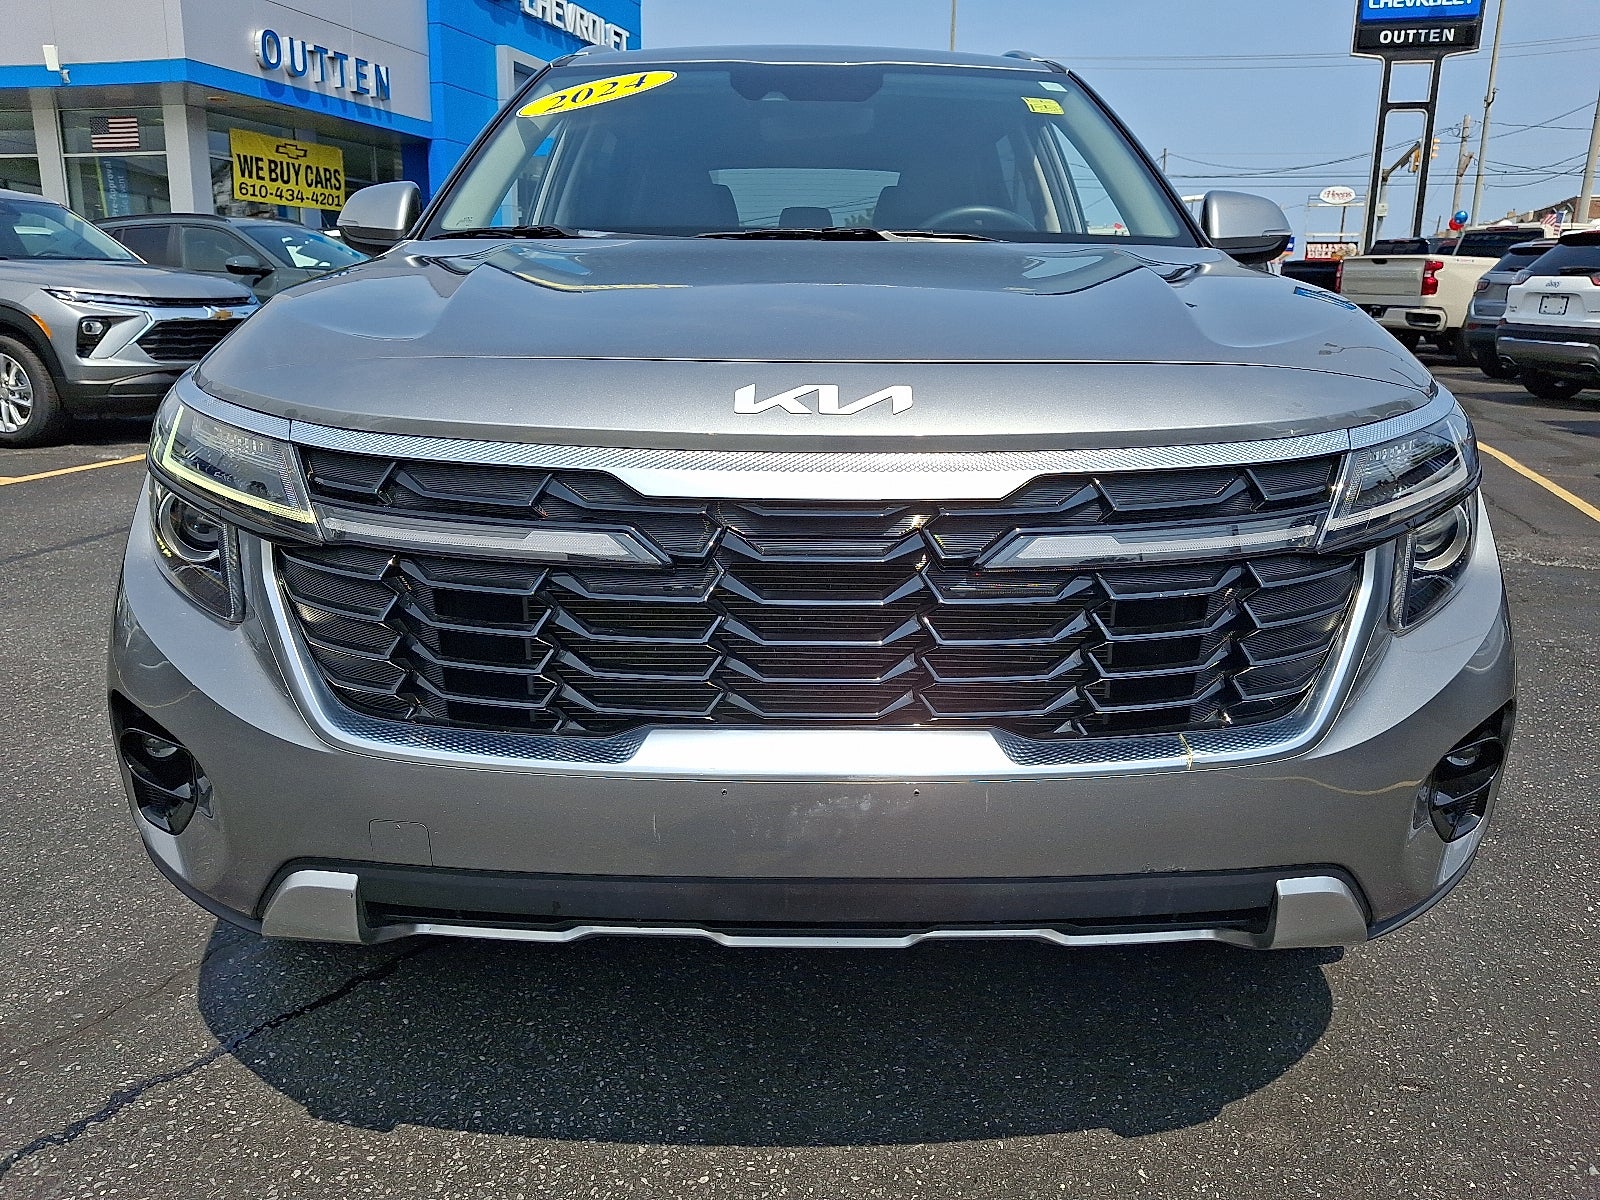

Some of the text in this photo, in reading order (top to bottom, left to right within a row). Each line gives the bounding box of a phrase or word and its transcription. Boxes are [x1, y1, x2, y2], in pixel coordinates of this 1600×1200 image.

[1379, 28, 1455, 44] OUTTEN
[256, 29, 391, 101] OUTTEN
[544, 73, 648, 113] 2024
[236, 153, 342, 191] WE BUY CARS
[239, 182, 343, 207] 610-434-4201
